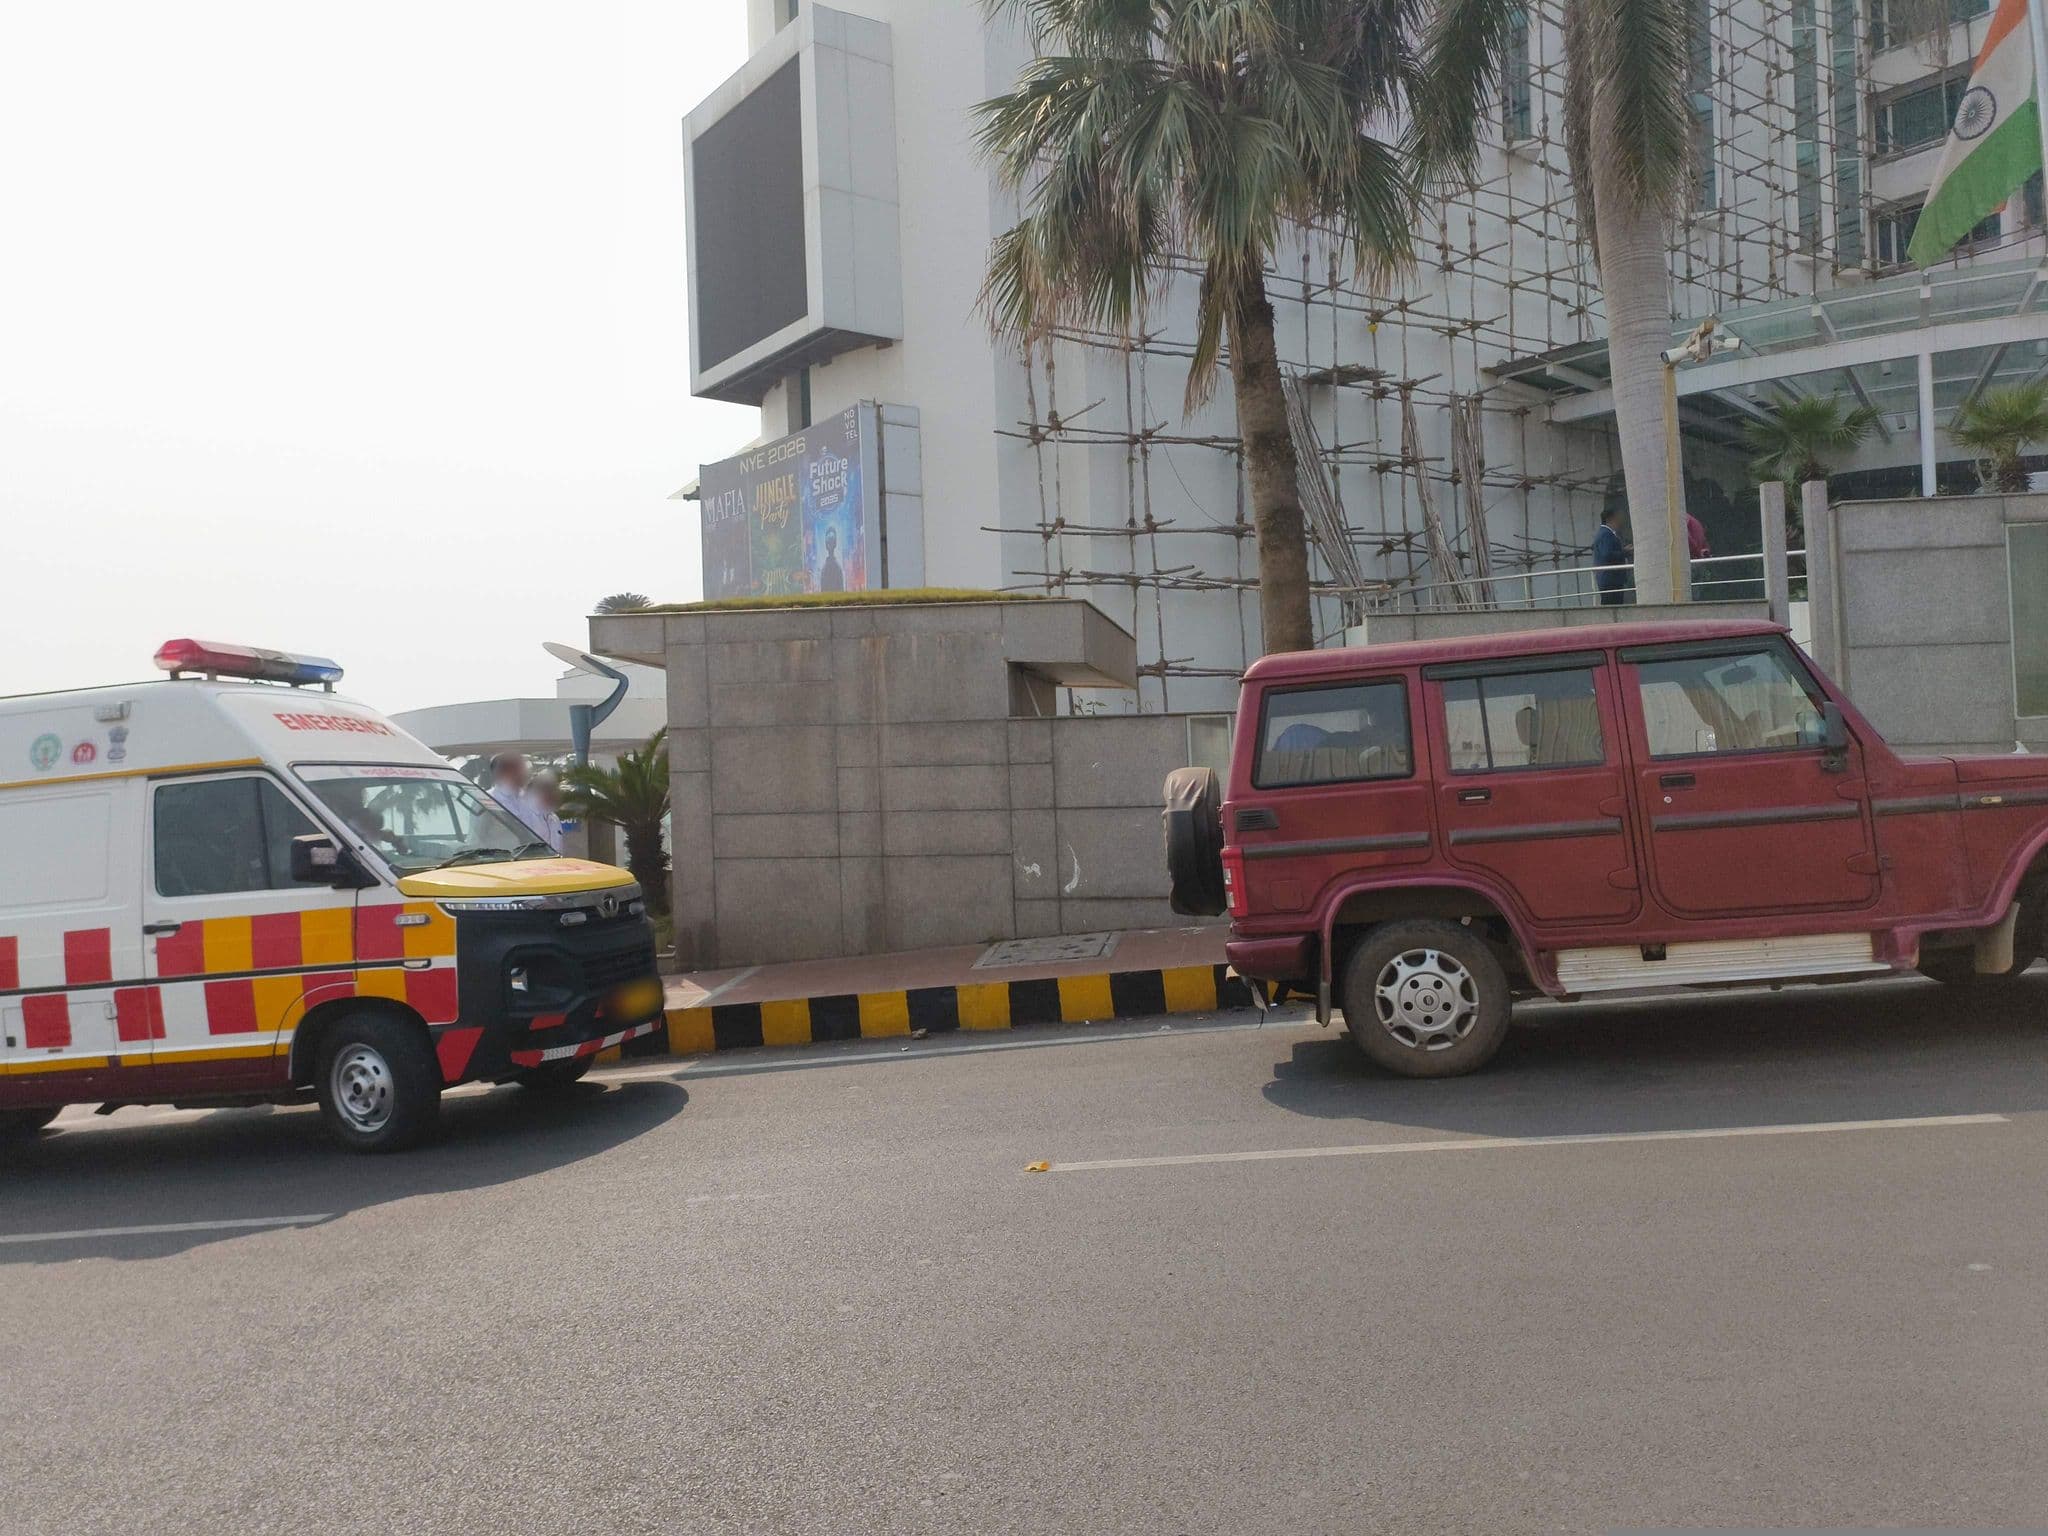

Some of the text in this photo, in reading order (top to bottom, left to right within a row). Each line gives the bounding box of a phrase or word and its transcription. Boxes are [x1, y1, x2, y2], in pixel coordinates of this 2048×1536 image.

[844, 409, 855, 420] NO
[845, 419, 855, 429] VO
[845, 429, 858, 440] TEL
[740, 436, 806, 475] NYE 2026
[809, 457, 848, 479] Future
[704, 488, 746, 523] MAFIA
[753, 474, 796, 512] JUNGLE
[760, 502, 789, 530] Party
[272, 712, 396, 737] EMERGENCY
